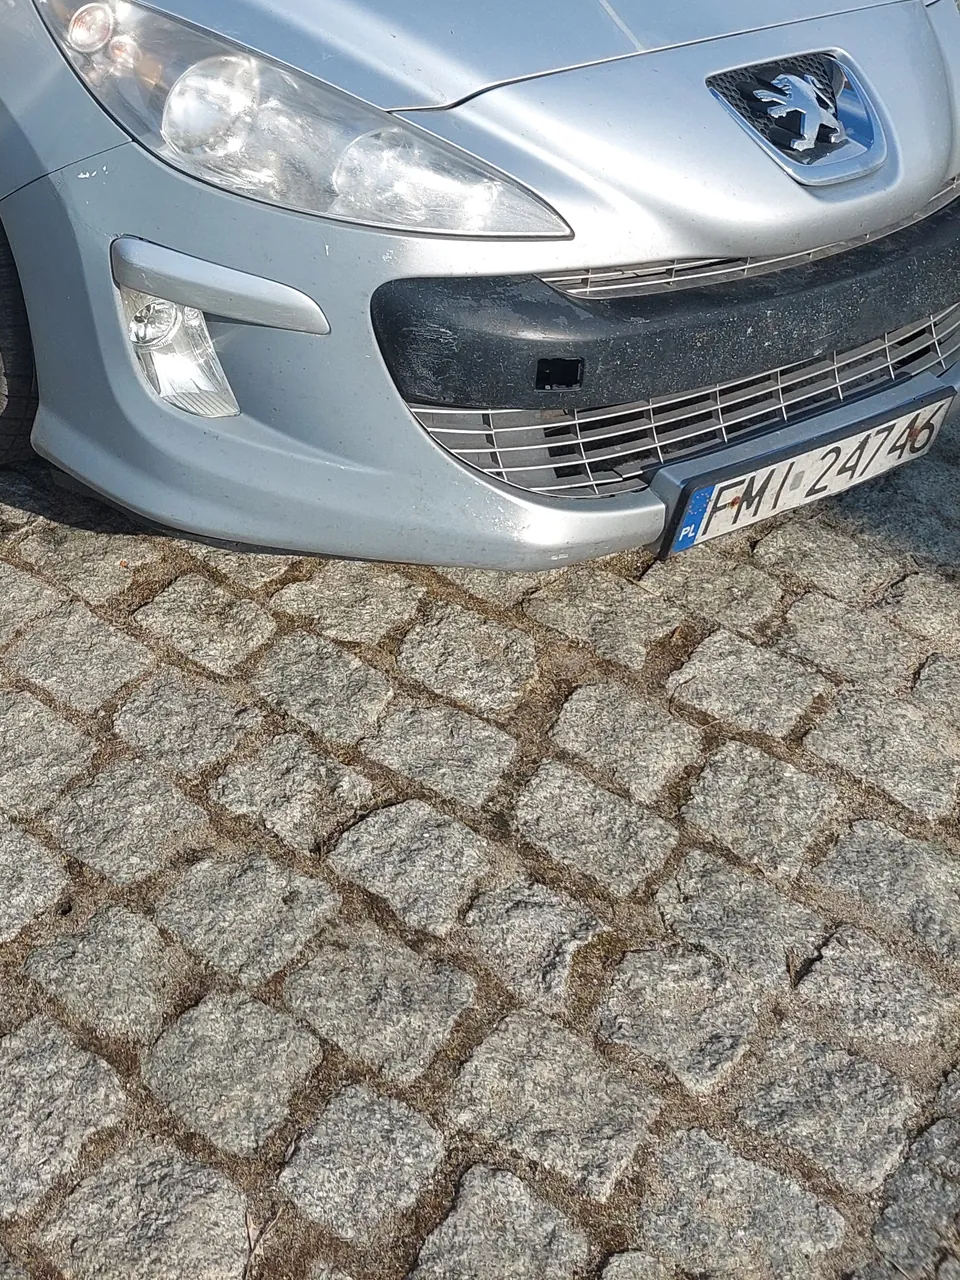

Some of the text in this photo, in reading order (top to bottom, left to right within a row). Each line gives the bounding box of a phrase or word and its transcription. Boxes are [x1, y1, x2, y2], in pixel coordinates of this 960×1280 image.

[701, 402, 945, 536] FMI 24746
[679, 524, 696, 542] PL
